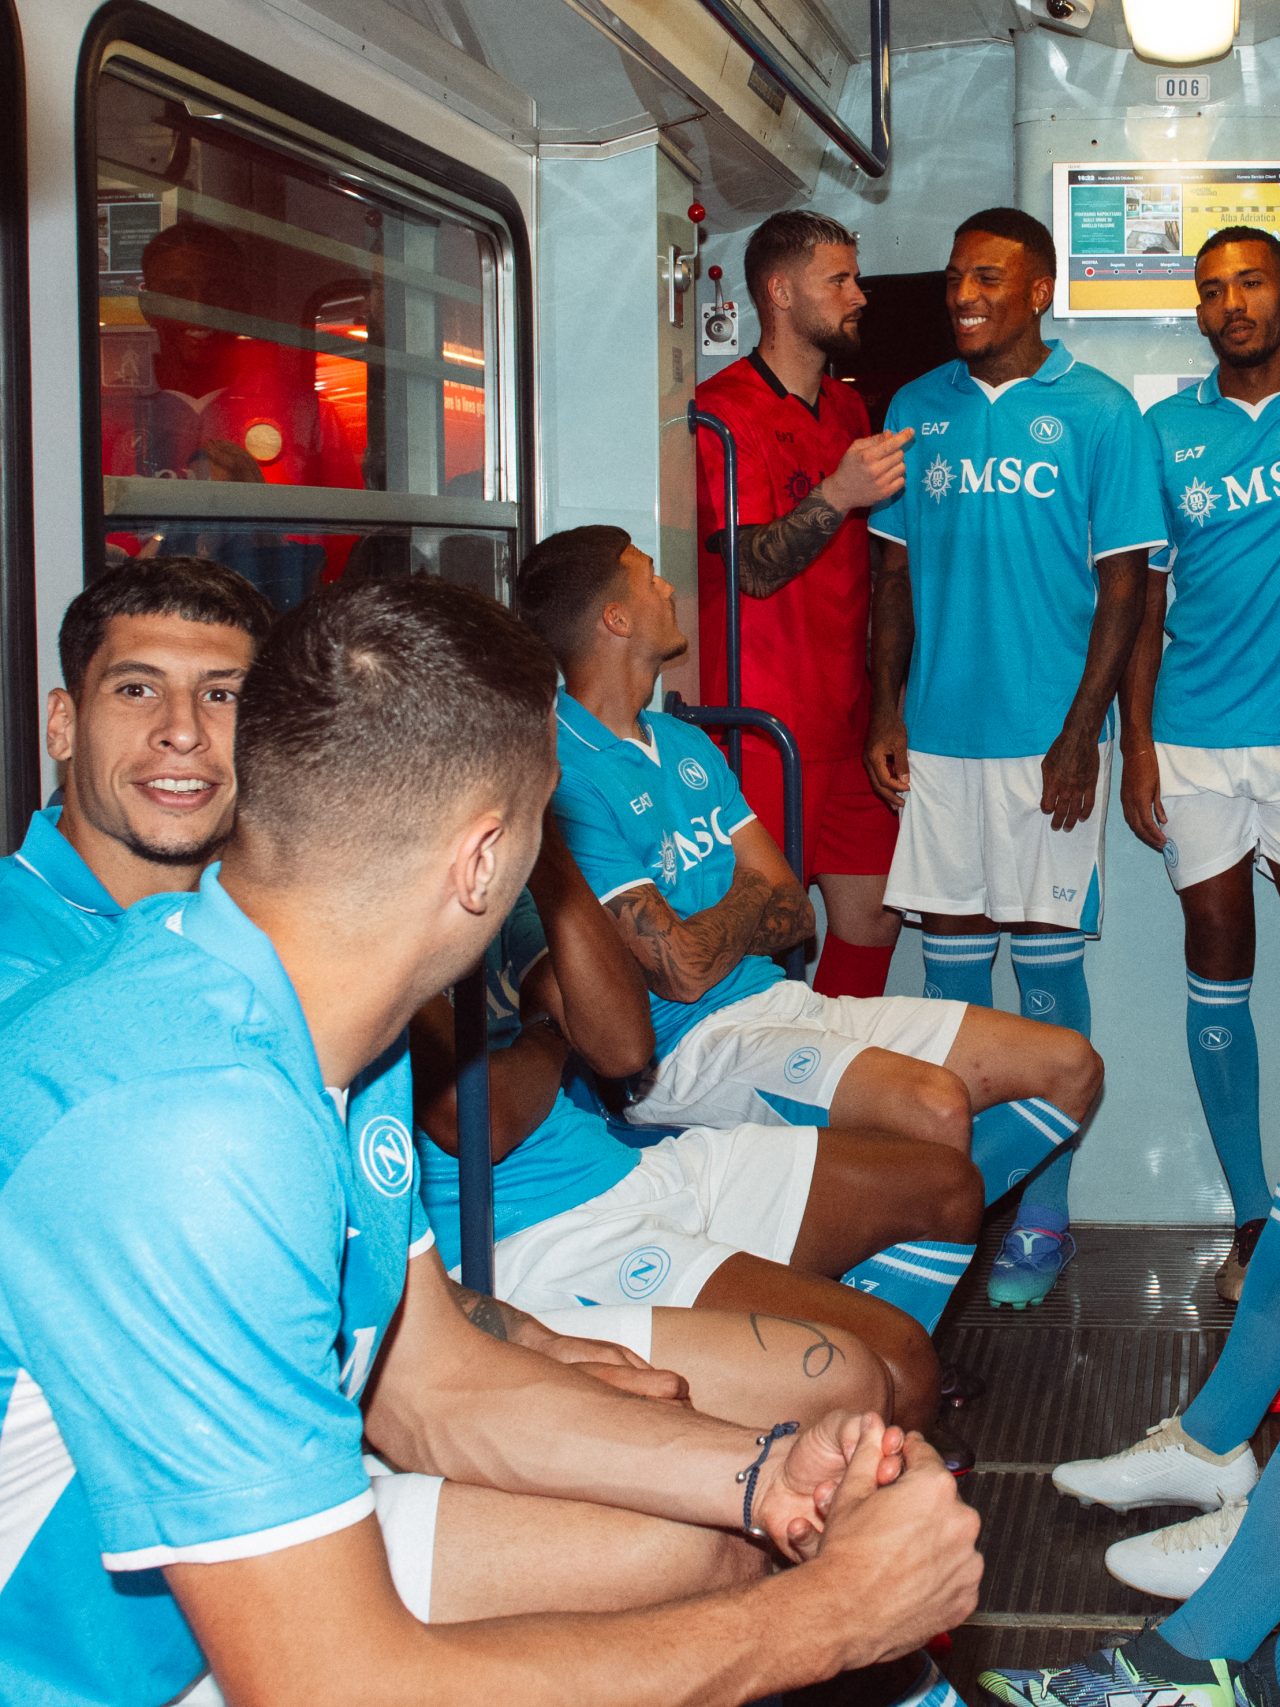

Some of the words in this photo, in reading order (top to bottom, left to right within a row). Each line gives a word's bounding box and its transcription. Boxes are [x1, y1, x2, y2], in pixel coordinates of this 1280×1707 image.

[1166, 79, 1199, 96] 006
[1220, 213, 1238, 222] Alba
[1240, 213, 1276, 222] Adriatica
[921, 421, 950, 435] EA7
[1175, 445, 1206, 463] EA7
[958, 457, 1059, 499] MSC
[629, 792, 654, 816] EA7
[1052, 885, 1077, 902] EA7
